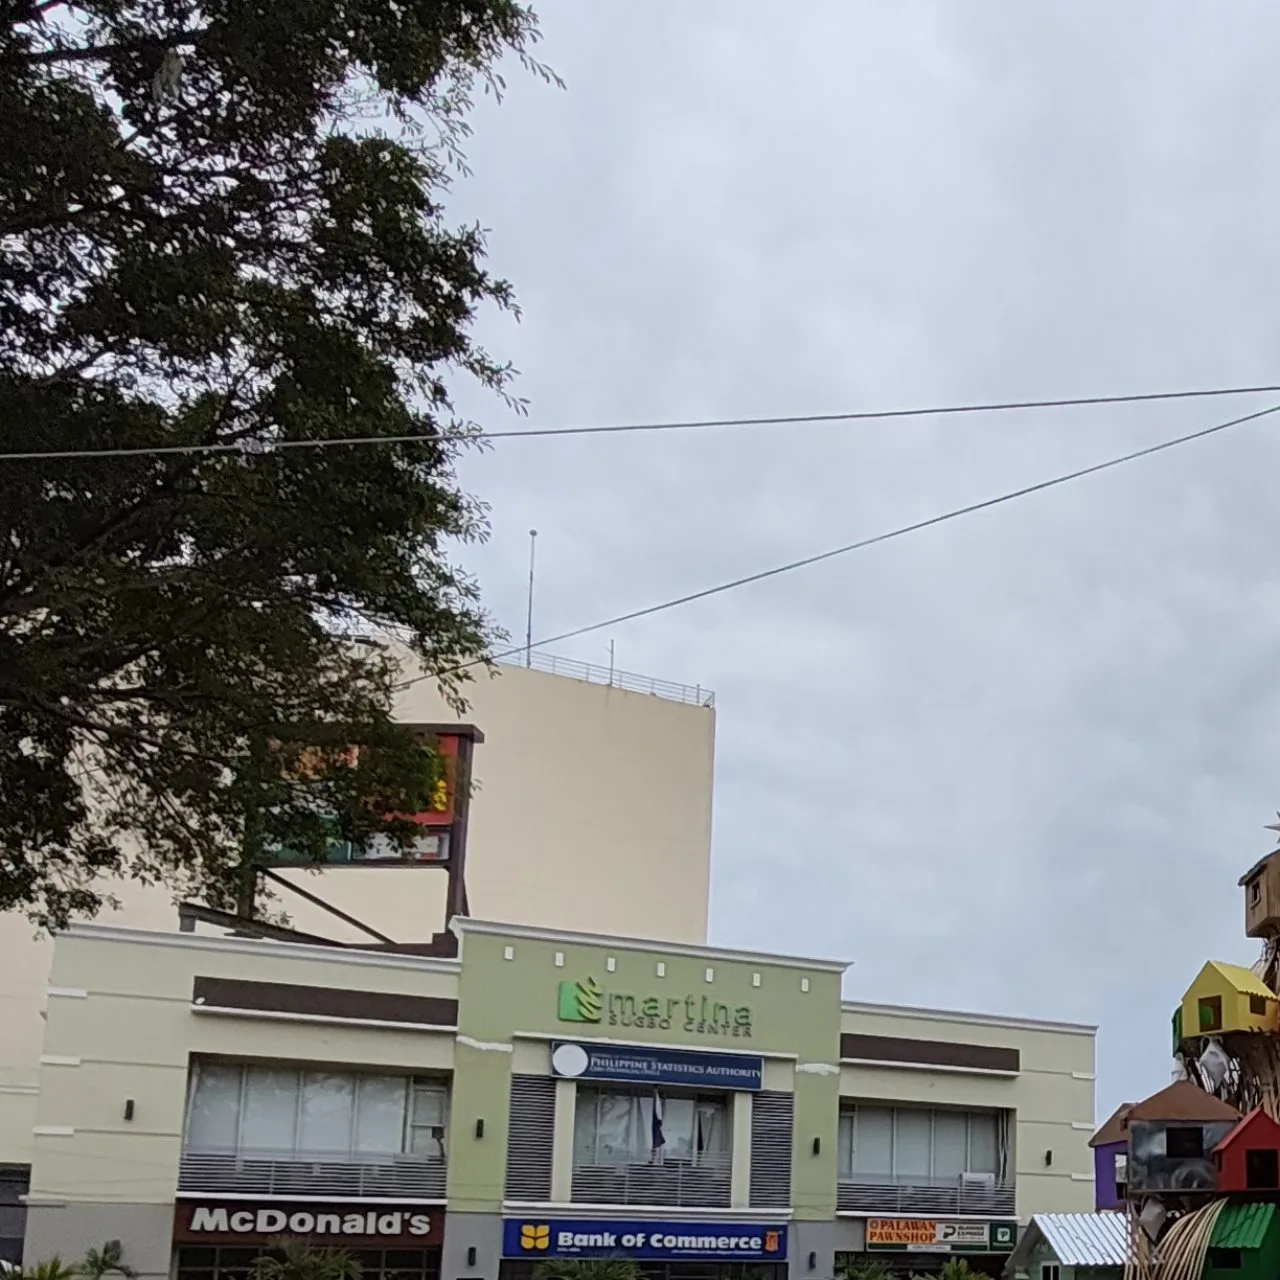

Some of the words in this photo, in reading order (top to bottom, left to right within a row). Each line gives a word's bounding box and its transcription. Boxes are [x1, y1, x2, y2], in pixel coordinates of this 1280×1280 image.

[608, 992, 753, 1027] martina
[683, 1019, 753, 1038] CENTER
[590, 1056, 648, 1070] PHILIPPINE
[651, 1060, 705, 1075] STATISTICS
[706, 1065, 762, 1079] AUTHORITY
[189, 1206, 432, 1236] McDonald's
[879, 1219, 937, 1232] PALAWAN
[557, 1231, 617, 1249] Bank
[621, 1231, 646, 1249] of
[649, 1233, 763, 1251] Commerce
[869, 1230, 937, 1244] PAWNSHOP
